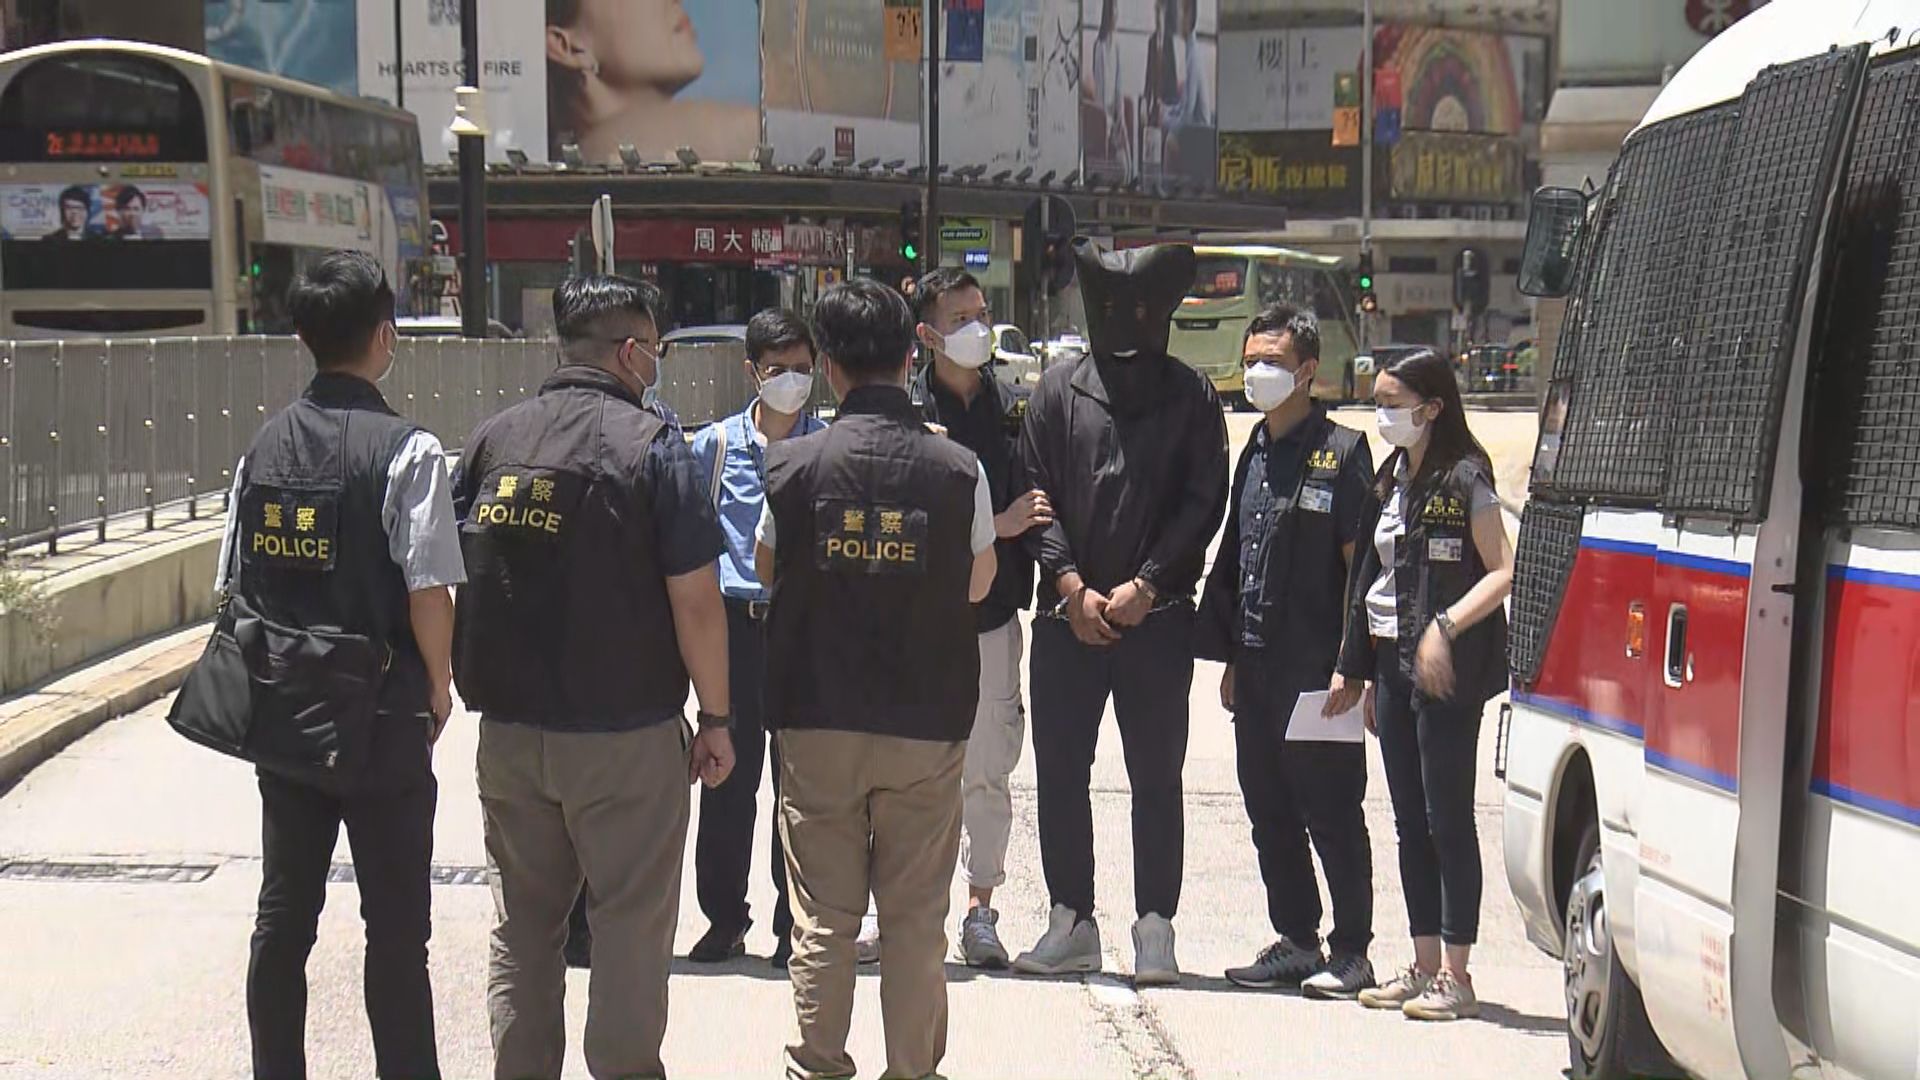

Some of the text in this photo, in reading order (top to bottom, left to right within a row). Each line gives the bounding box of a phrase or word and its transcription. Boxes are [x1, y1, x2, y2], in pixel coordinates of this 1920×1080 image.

[484, 61, 521, 76] FIRE
[497, 475, 555, 502] 警察
[264, 502, 316, 532] 警察
[477, 503, 562, 534] POLICE
[844, 510, 903, 534] 警察
[253, 531, 330, 560] POLICE
[826, 537, 917, 562] POLICE
